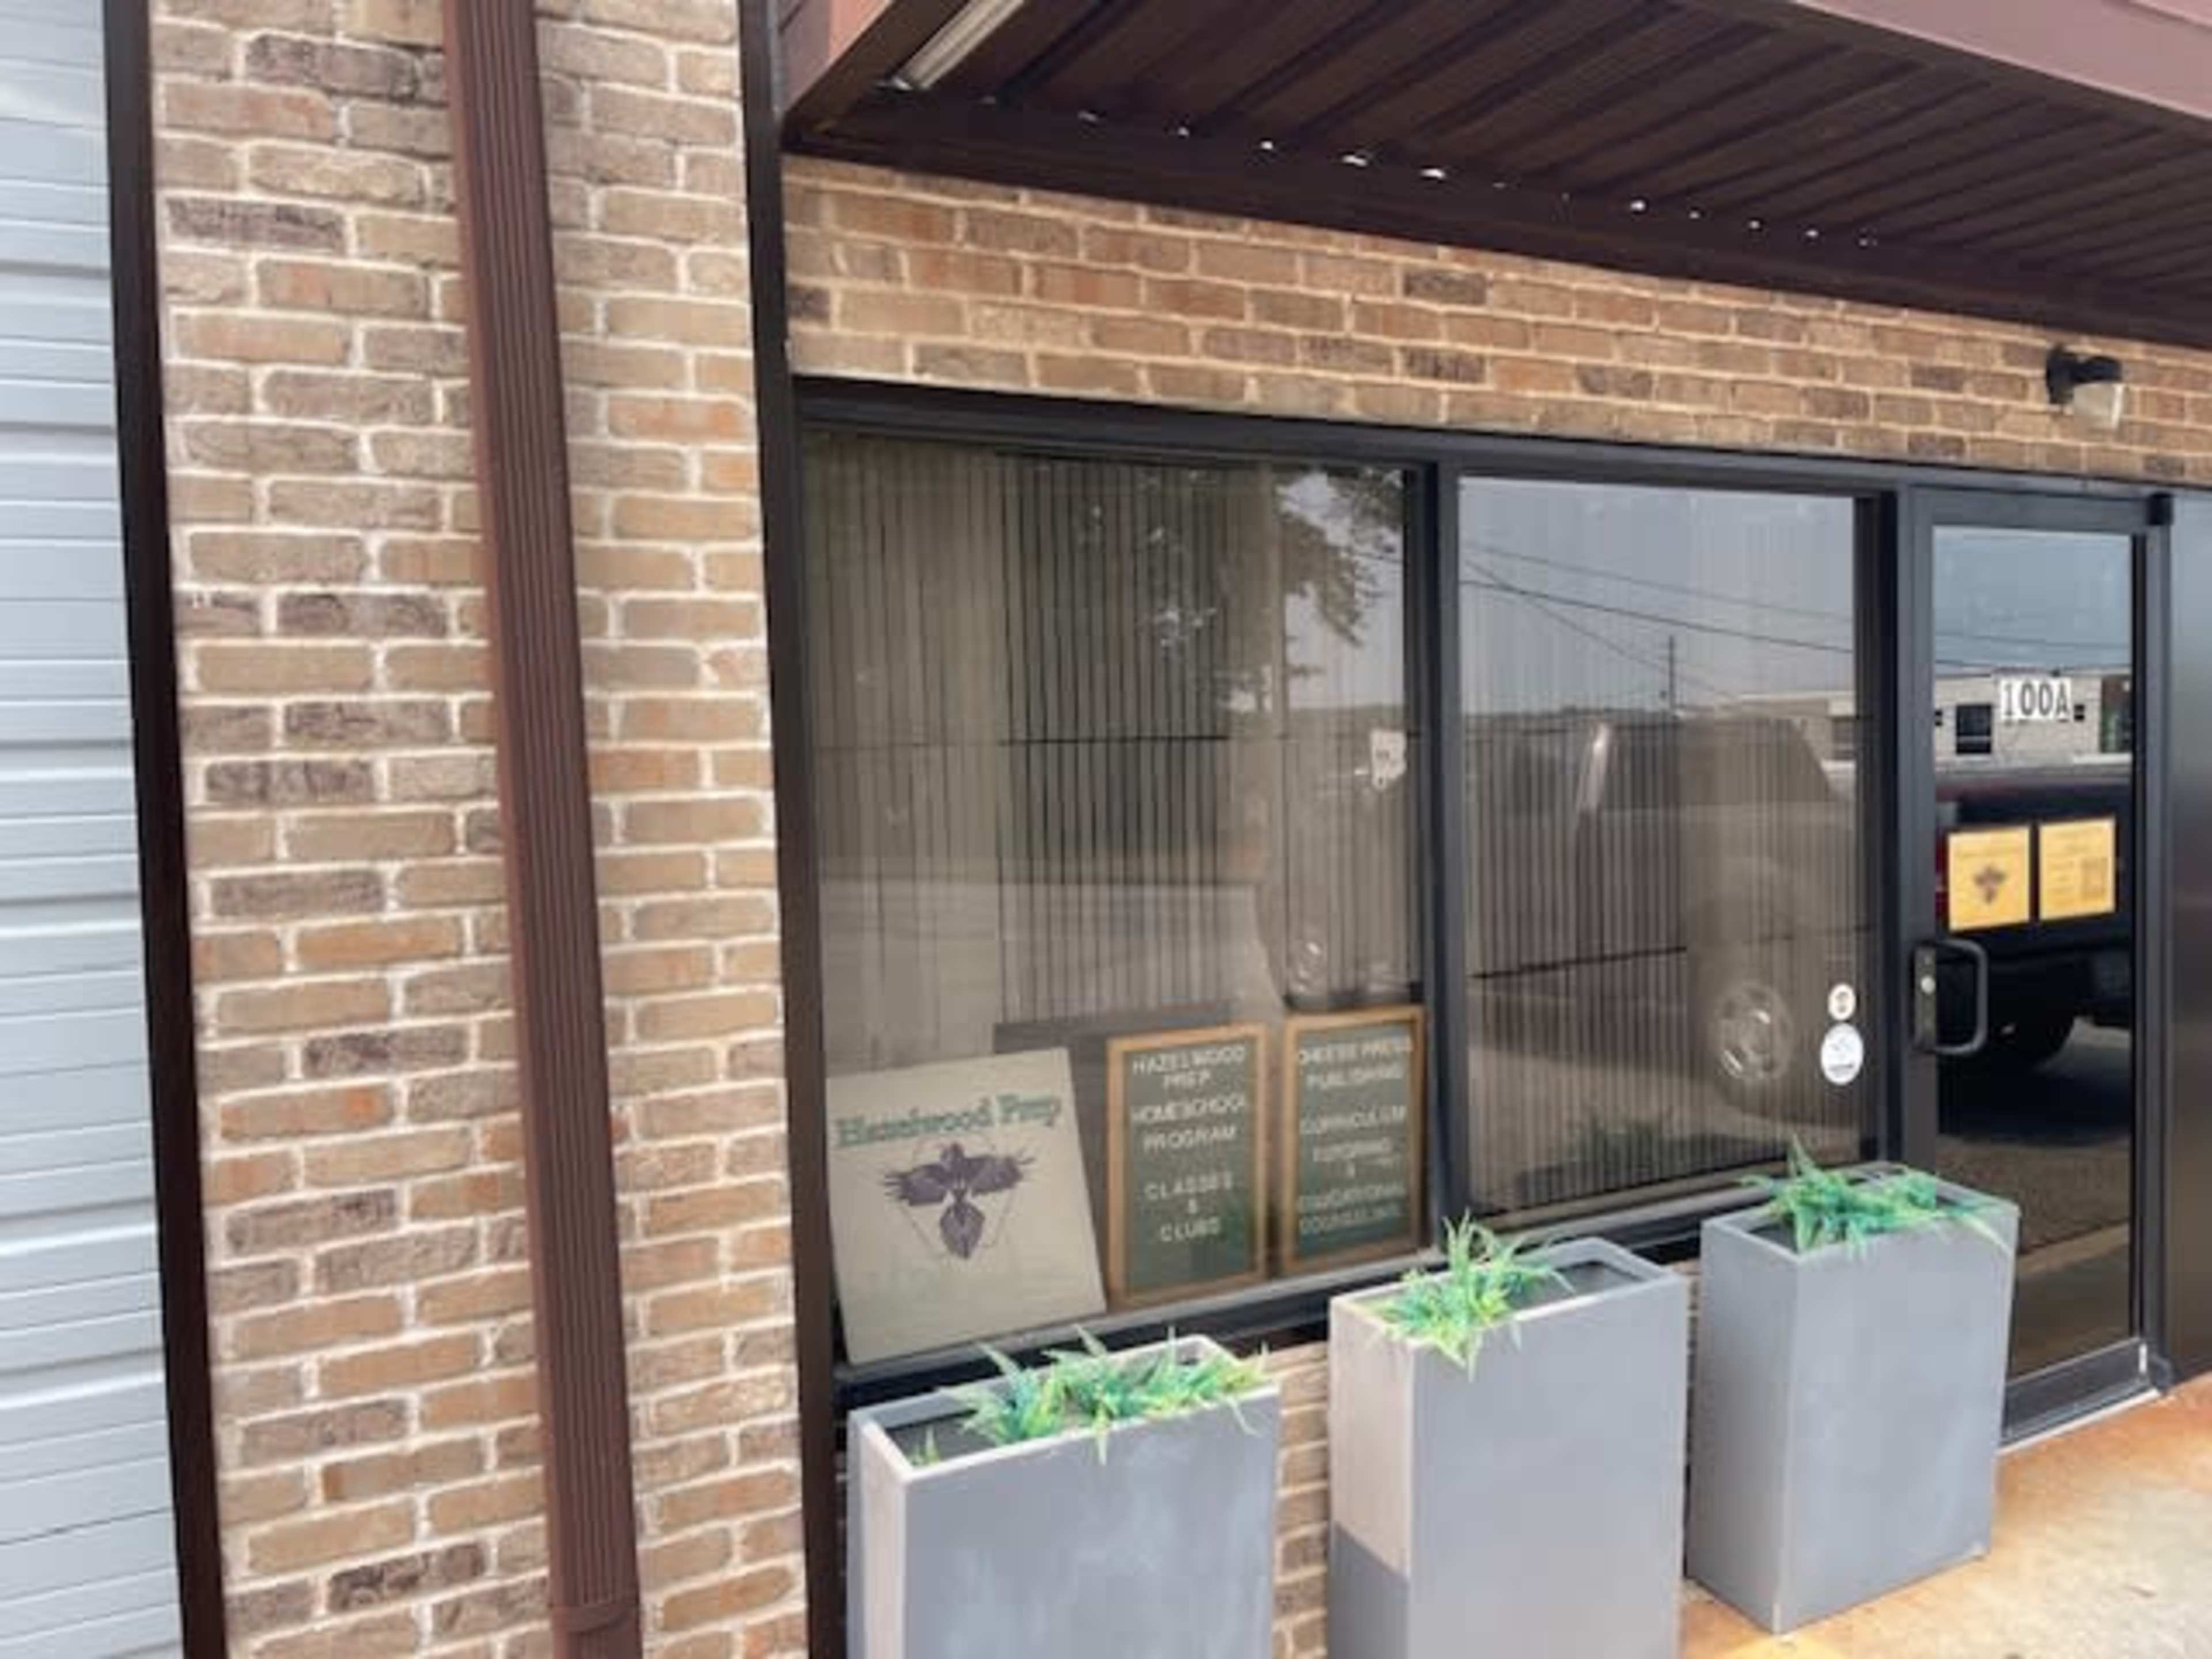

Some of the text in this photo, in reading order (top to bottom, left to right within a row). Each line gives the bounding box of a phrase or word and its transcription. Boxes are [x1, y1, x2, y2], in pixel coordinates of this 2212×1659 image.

[2003, 681, 2070, 717] 100A
[1132, 1045, 1245, 1075] HAZELWOOD
[1163, 1069, 1211, 1090] PREP
[1130, 1094, 1246, 1123] HOMESCHOOL
[1143, 1126, 1236, 1153] PROGRAM
[1144, 1171, 1233, 1200] CLASSES
[1160, 1217, 1221, 1242] CLUBS
